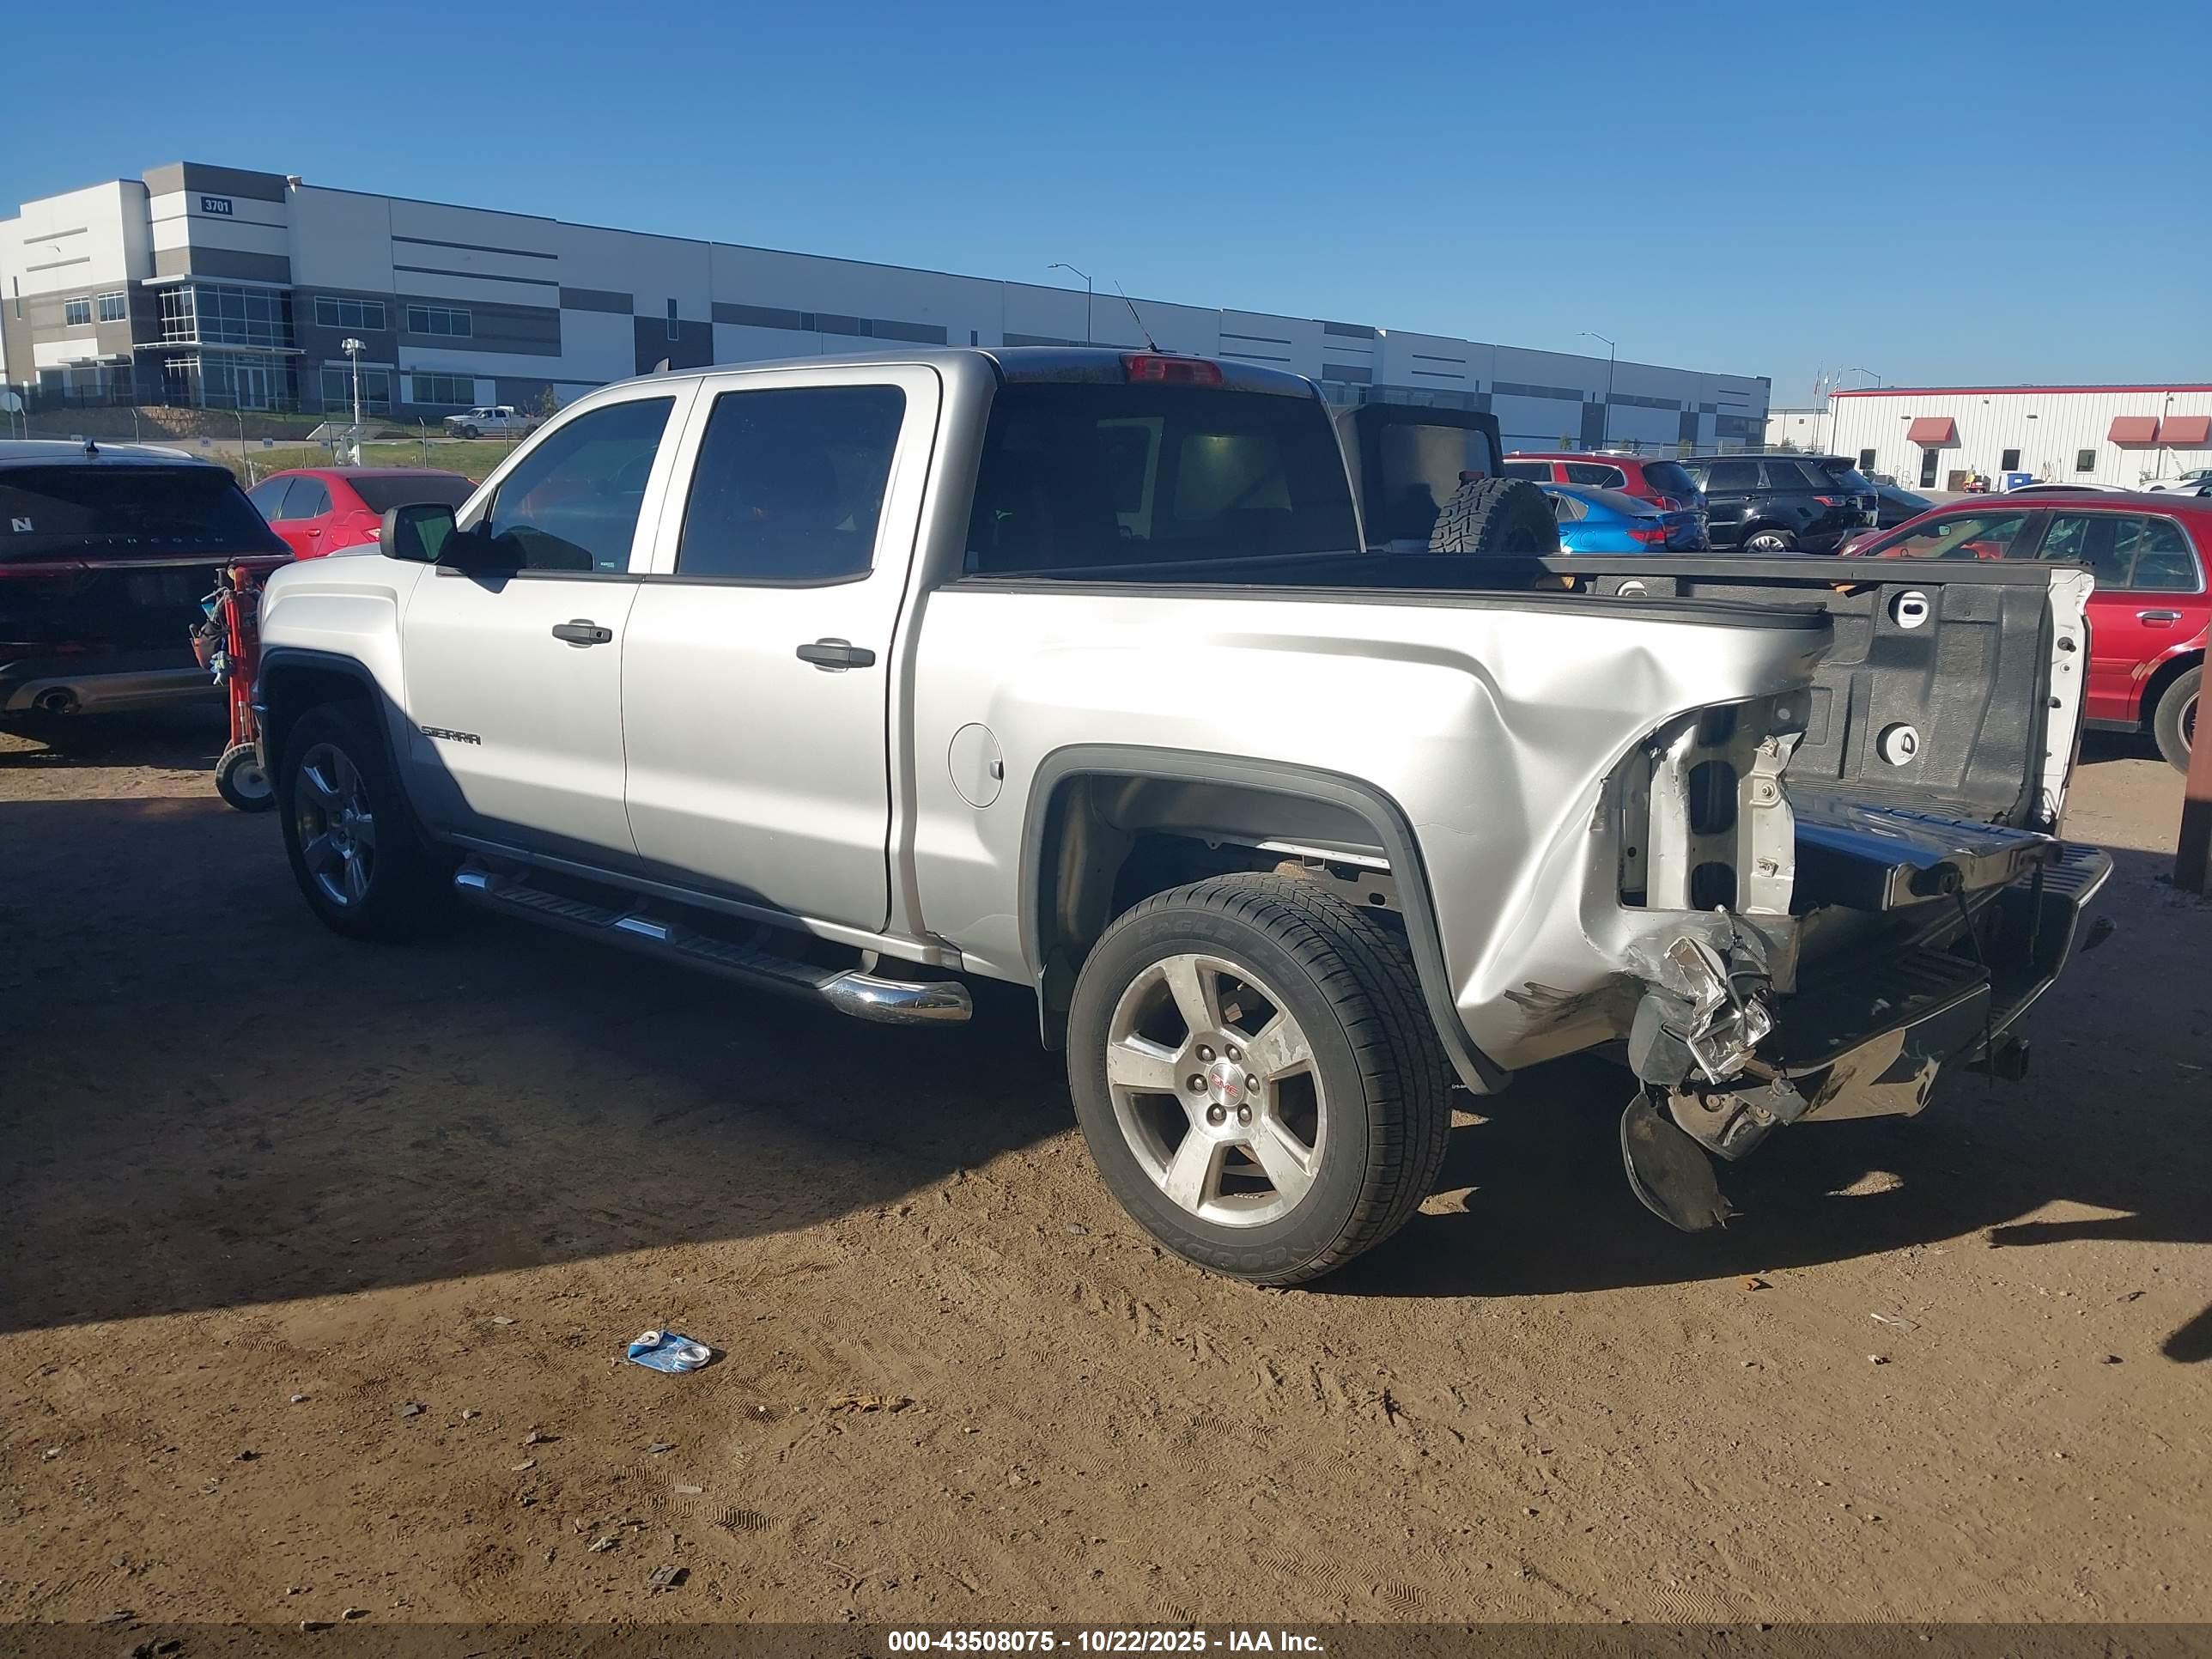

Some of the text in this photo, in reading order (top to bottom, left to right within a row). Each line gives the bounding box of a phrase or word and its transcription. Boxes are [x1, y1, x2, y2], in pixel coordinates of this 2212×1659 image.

[205, 199, 228, 213] 3701
[421, 725, 482, 746] SIERRA
[1209, 1073, 1238, 1097] GMC
